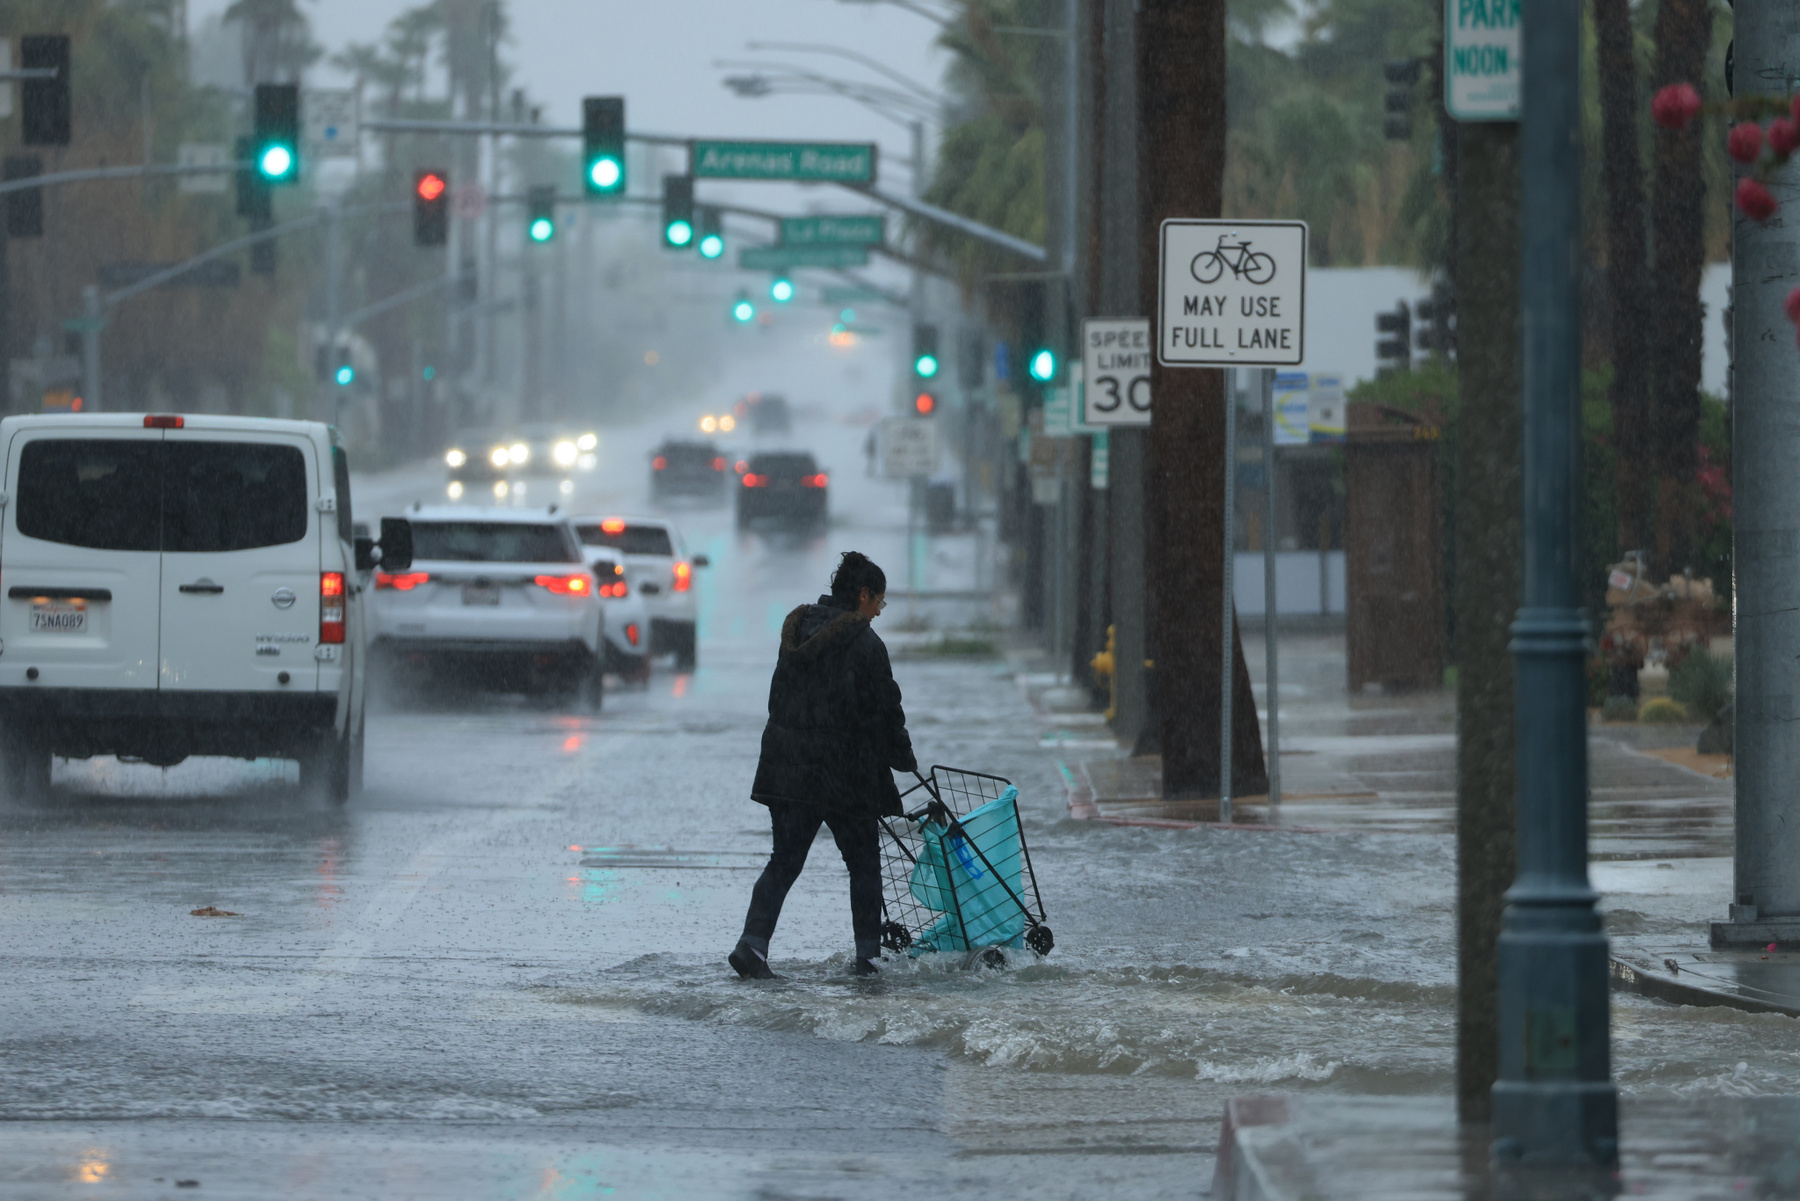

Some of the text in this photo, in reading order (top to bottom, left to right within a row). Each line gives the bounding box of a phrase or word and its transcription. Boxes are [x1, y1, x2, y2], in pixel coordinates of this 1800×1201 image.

[702, 148, 866, 173] Arenas Road
[1183, 295, 1281, 317] MAY USE
[1090, 331, 1150, 348] SPEE
[1171, 327, 1291, 349] FULL LANE
[1098, 353, 1151, 369] LIMIT
[1094, 375, 1152, 412] 30
[33, 612, 83, 629] 7SNA089
